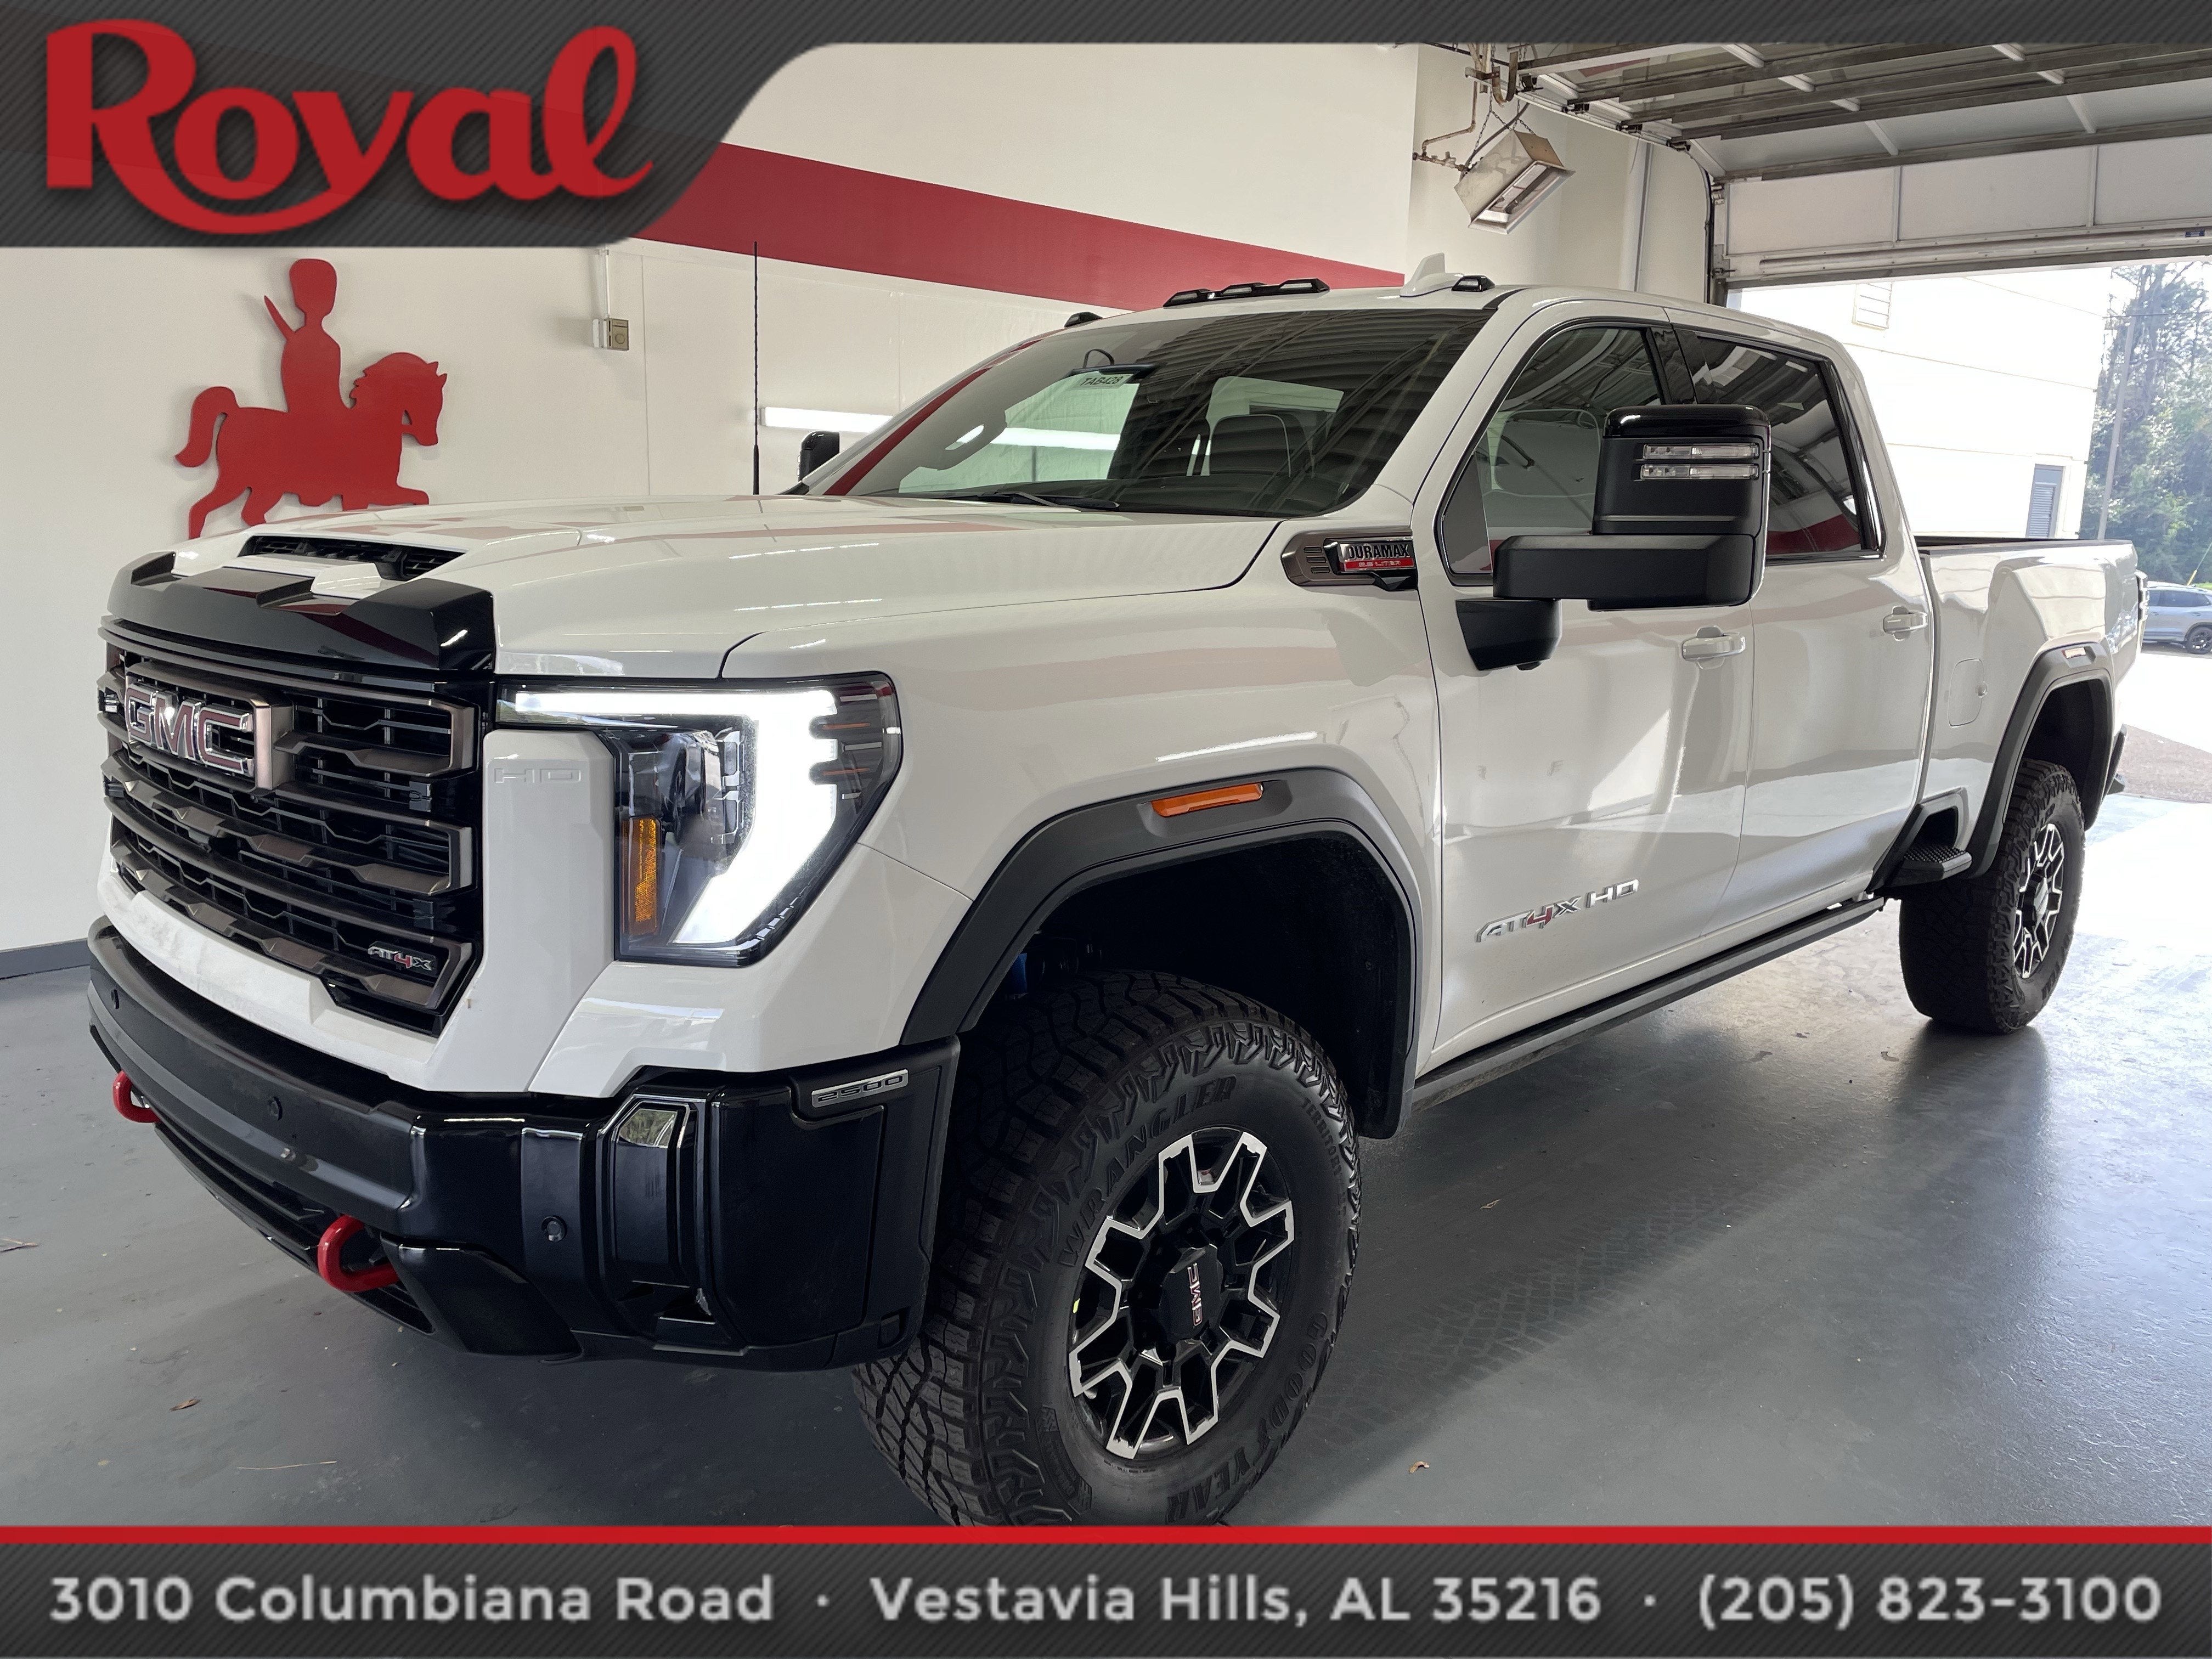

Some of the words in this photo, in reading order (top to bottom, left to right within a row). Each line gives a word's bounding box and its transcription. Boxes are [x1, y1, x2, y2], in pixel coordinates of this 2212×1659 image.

[1080, 375, 1124, 386] TAB428
[1347, 544, 1410, 560] DURAMAX
[125, 682, 255, 777] GMC
[494, 768, 581, 783] HD
[1476, 895, 1582, 943] AT4X
[1585, 879, 1640, 909] HD
[367, 946, 432, 971] AT4X
[817, 1075, 903, 1103] 2500
[1058, 1074, 1238, 1267] WRANGLER
[1187, 1262, 1204, 1326] GMC
